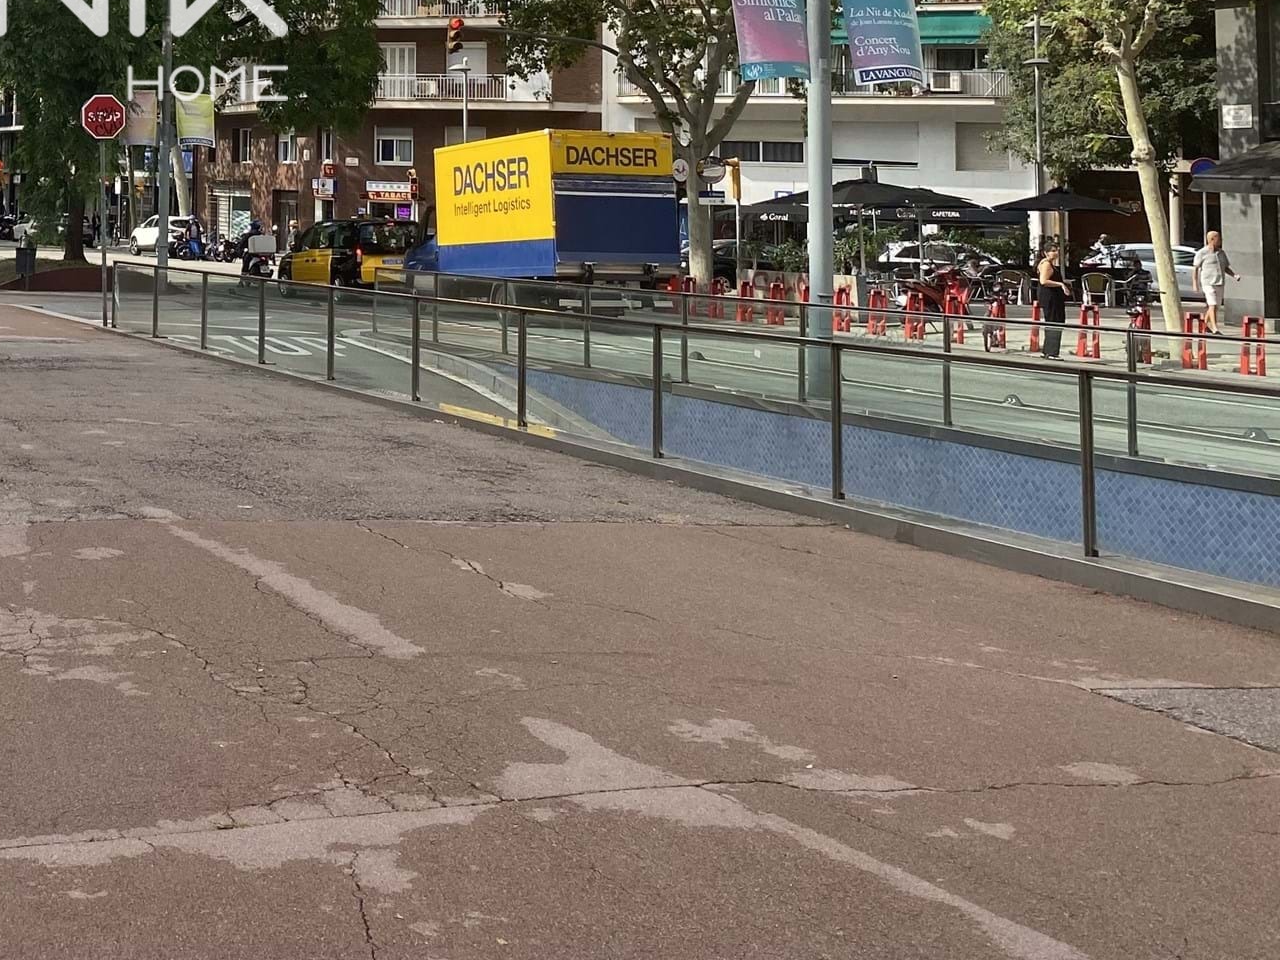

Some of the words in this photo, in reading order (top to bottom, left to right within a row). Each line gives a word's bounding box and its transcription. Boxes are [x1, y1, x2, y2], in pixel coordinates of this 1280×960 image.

[763, 8, 774, 21] al
[849, 7, 864, 18] La
[865, 6, 882, 17] Nit
[882, 7, 892, 17] de
[854, 35, 898, 47] Concert
[856, 45, 888, 57] d'Any
[889, 44, 911, 56] Nou
[862, 71, 875, 81] LA
[87, 111, 121, 122] STOP
[566, 145, 658, 168] DACHSER
[453, 156, 530, 197] DACHSER
[454, 200, 491, 217] Intelligent
[493, 197, 531, 214] Logistics
